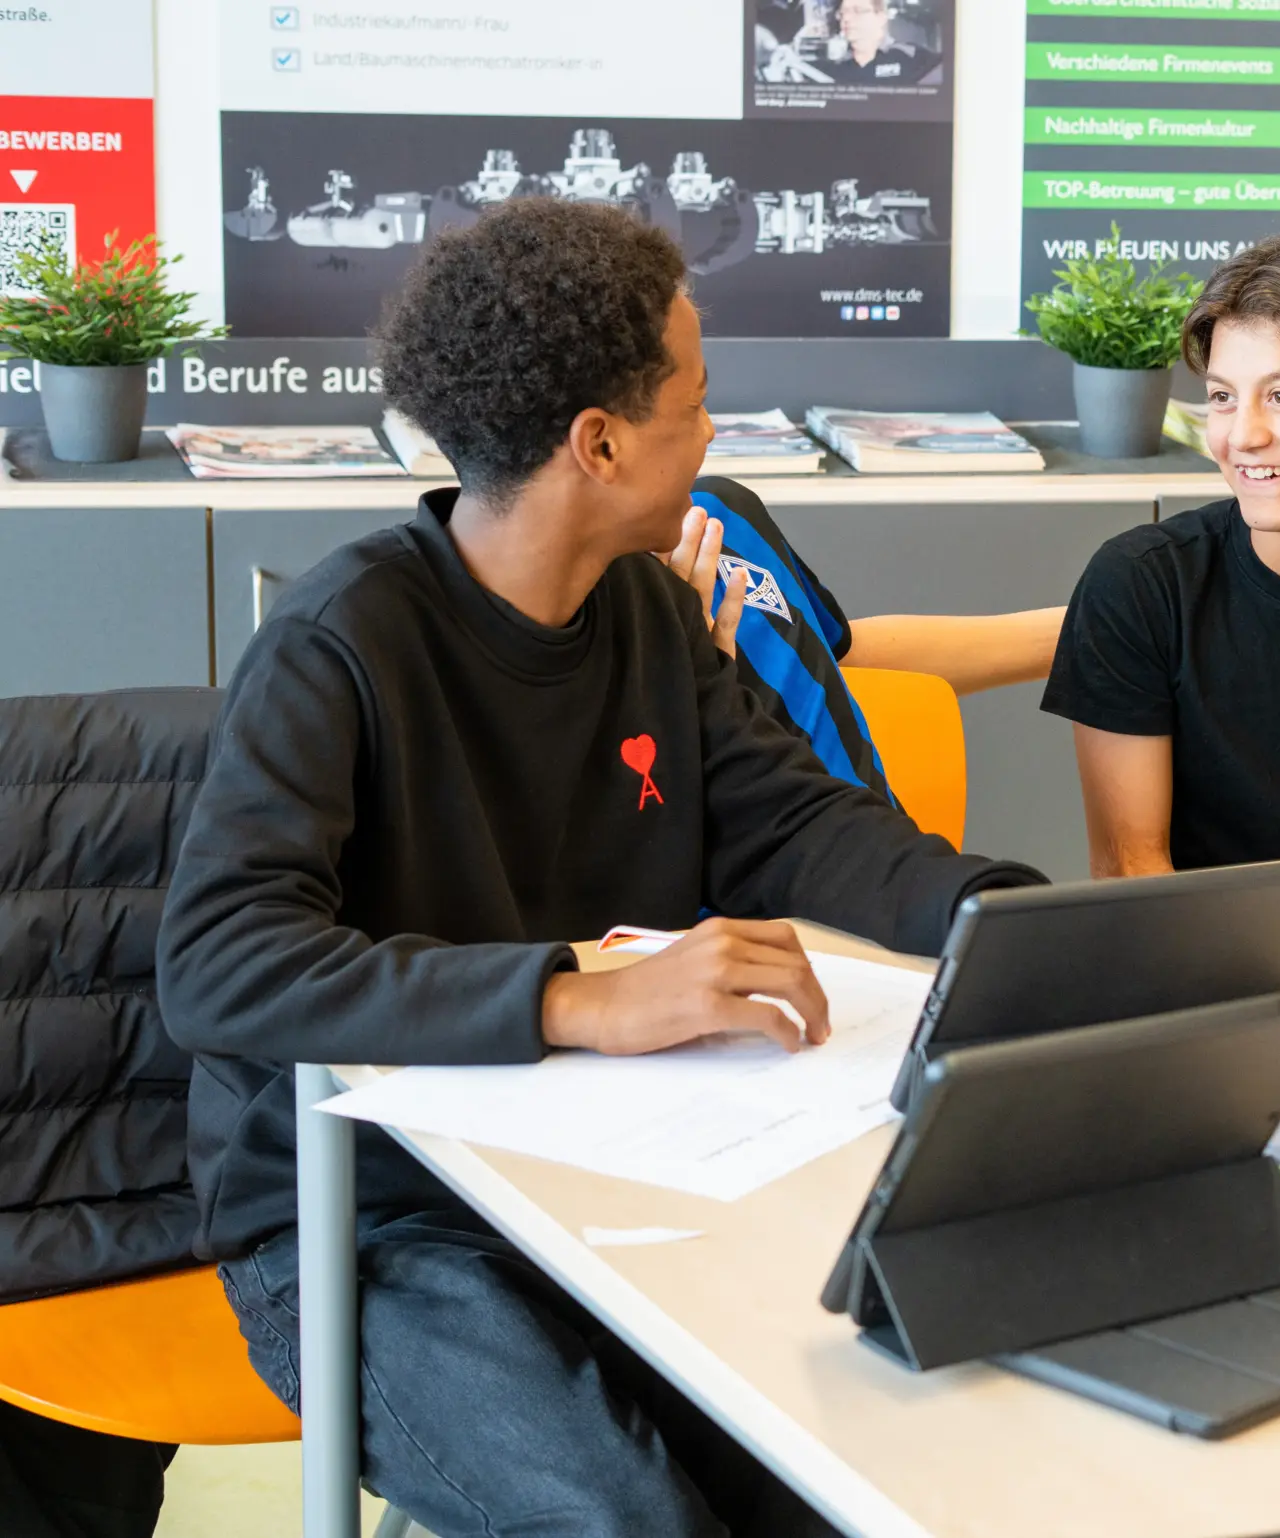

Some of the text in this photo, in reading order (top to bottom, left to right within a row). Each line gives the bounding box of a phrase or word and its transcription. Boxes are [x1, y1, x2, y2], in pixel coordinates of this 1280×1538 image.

[1046, 51, 1274, 75] Verschiedene Firmenevents
[1044, 116, 1256, 140] Nachhaltige Firmenkultur
[0, 130, 122, 152] BEWERBEN
[1043, 180, 1175, 204] TOP-Betreuung
[1193, 187, 1230, 204] gute
[1043, 240, 1088, 260] WIR
[1184, 240, 1230, 261] UNS
[820, 287, 924, 303] www.dms-tec.de
[183, 357, 307, 393] Berufe
